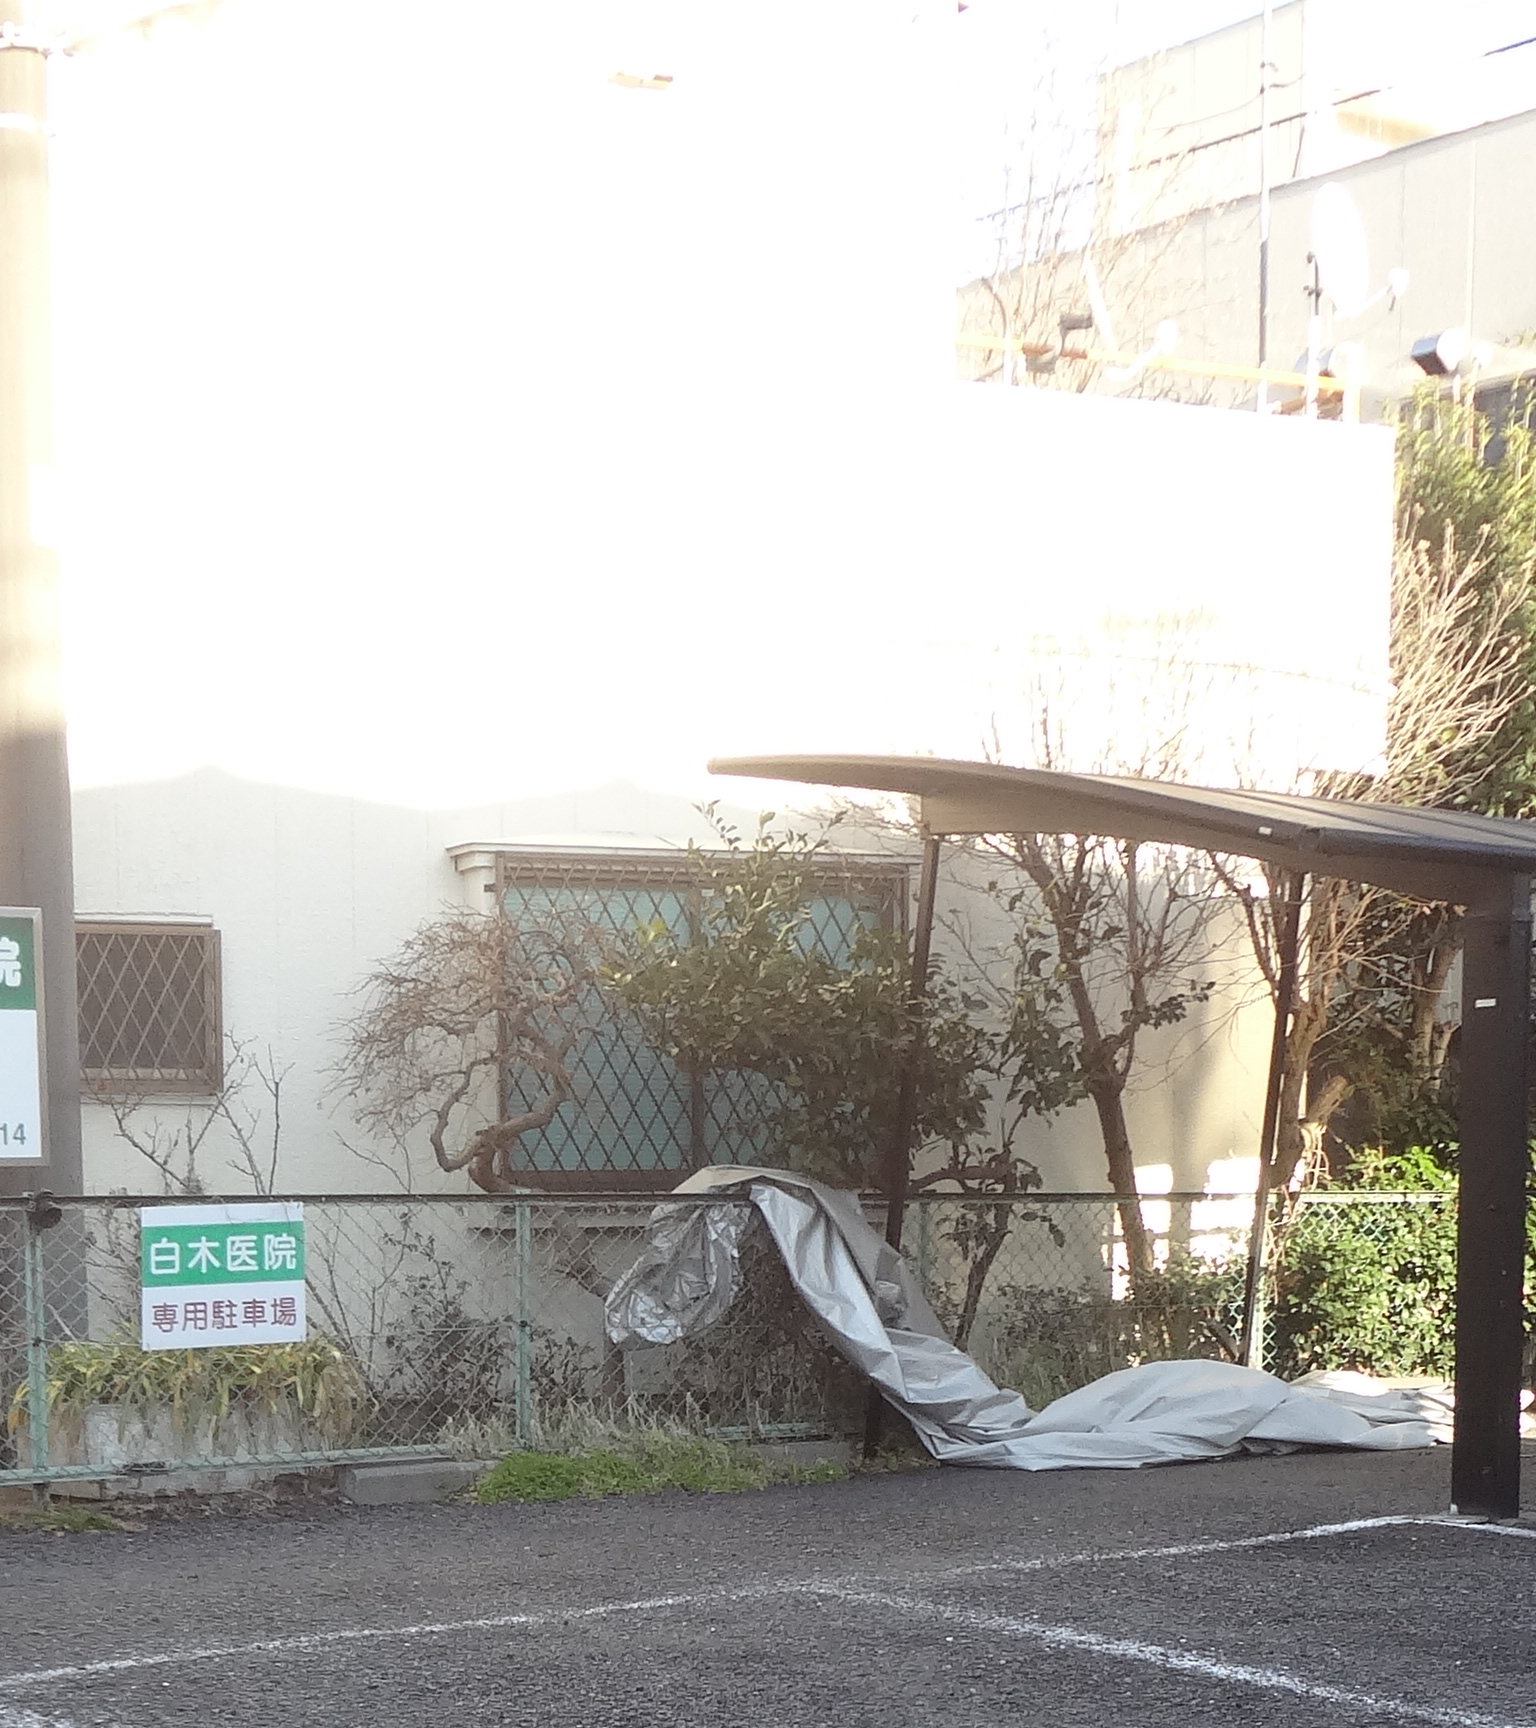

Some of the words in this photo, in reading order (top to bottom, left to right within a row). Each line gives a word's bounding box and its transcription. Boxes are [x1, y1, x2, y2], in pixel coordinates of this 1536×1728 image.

[150, 1233, 297, 1275] 白木医院
[152, 1297, 297, 1333] 専用駐車場
